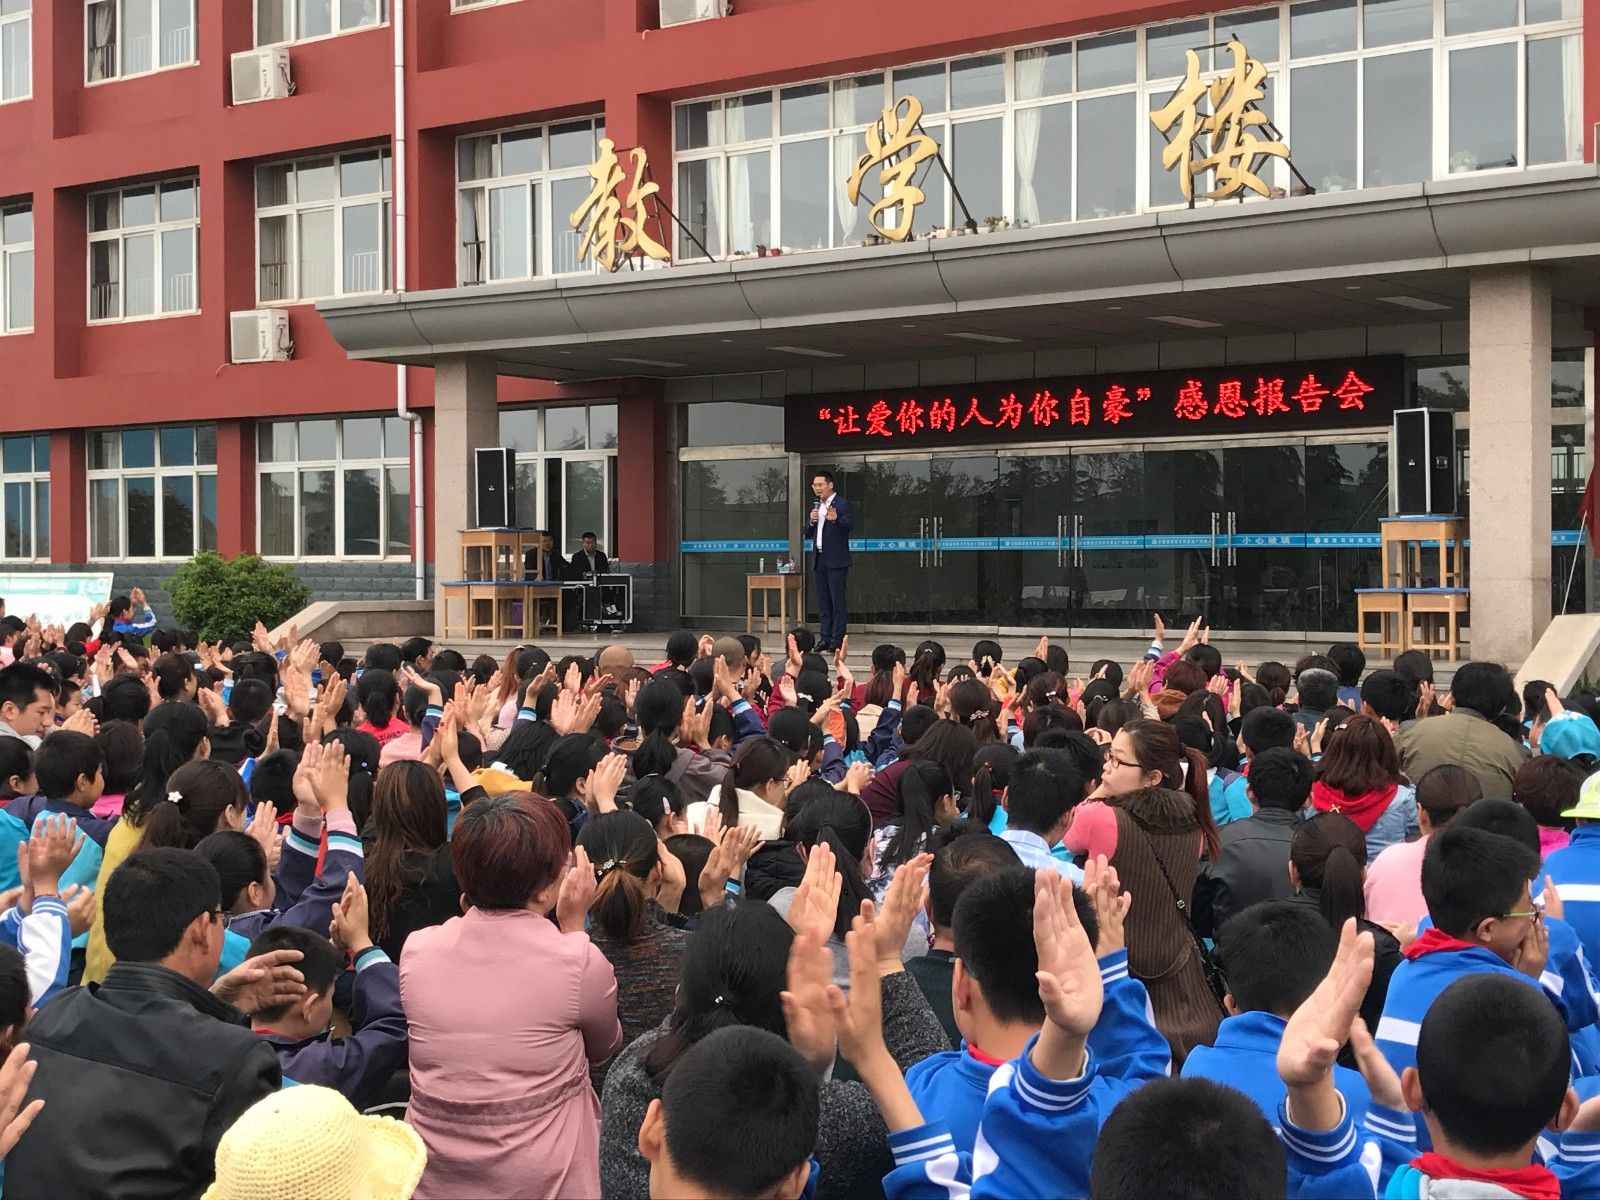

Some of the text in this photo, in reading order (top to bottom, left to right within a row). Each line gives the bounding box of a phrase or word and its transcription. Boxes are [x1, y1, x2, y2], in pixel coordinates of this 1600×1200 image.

[1173, 370, 1374, 419] 感恩报告会
